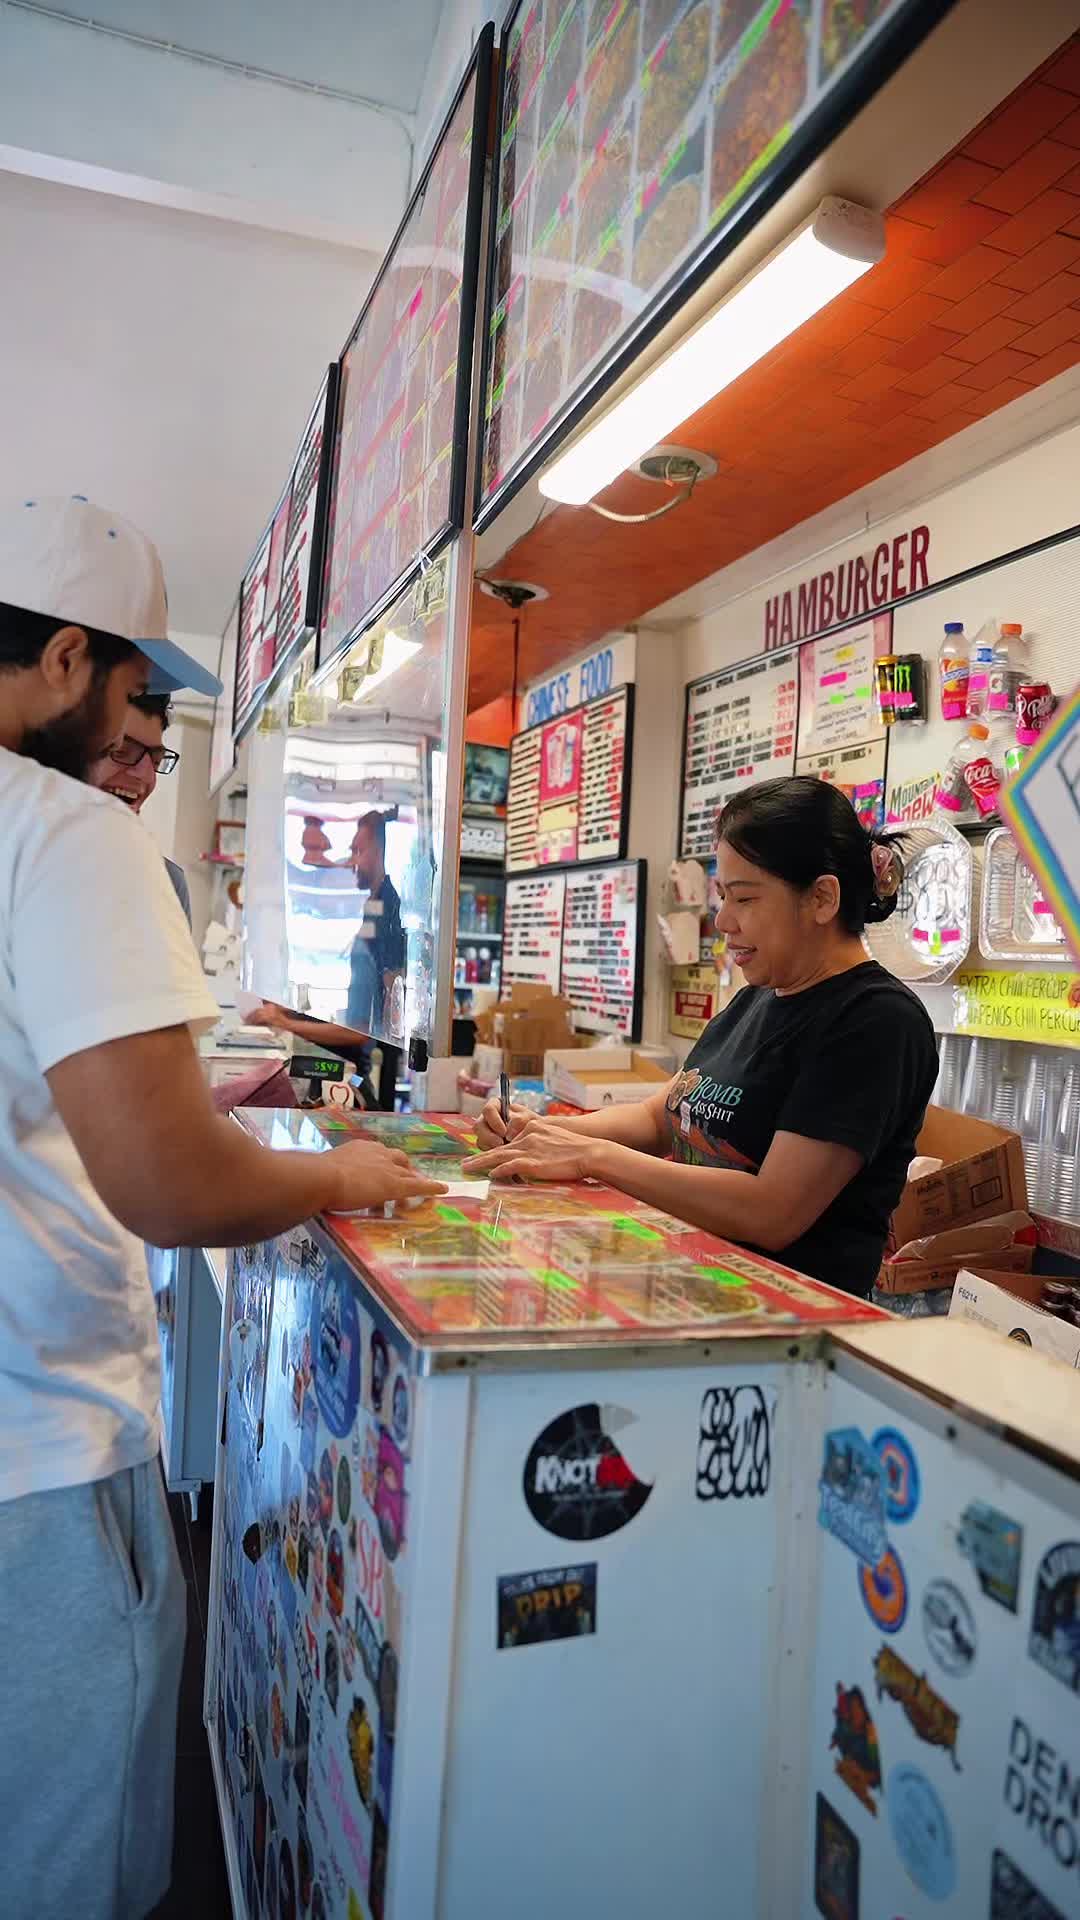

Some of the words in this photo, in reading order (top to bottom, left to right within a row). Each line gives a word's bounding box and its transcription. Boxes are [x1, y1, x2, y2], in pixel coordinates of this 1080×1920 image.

[765, 525, 930, 652] HAMBURGER
[528, 672, 571, 727] CHINESE
[580, 649, 612, 702] FOOD
[959, 975, 997, 997] EXTRA
[689, 1076, 744, 1106] BOMB
